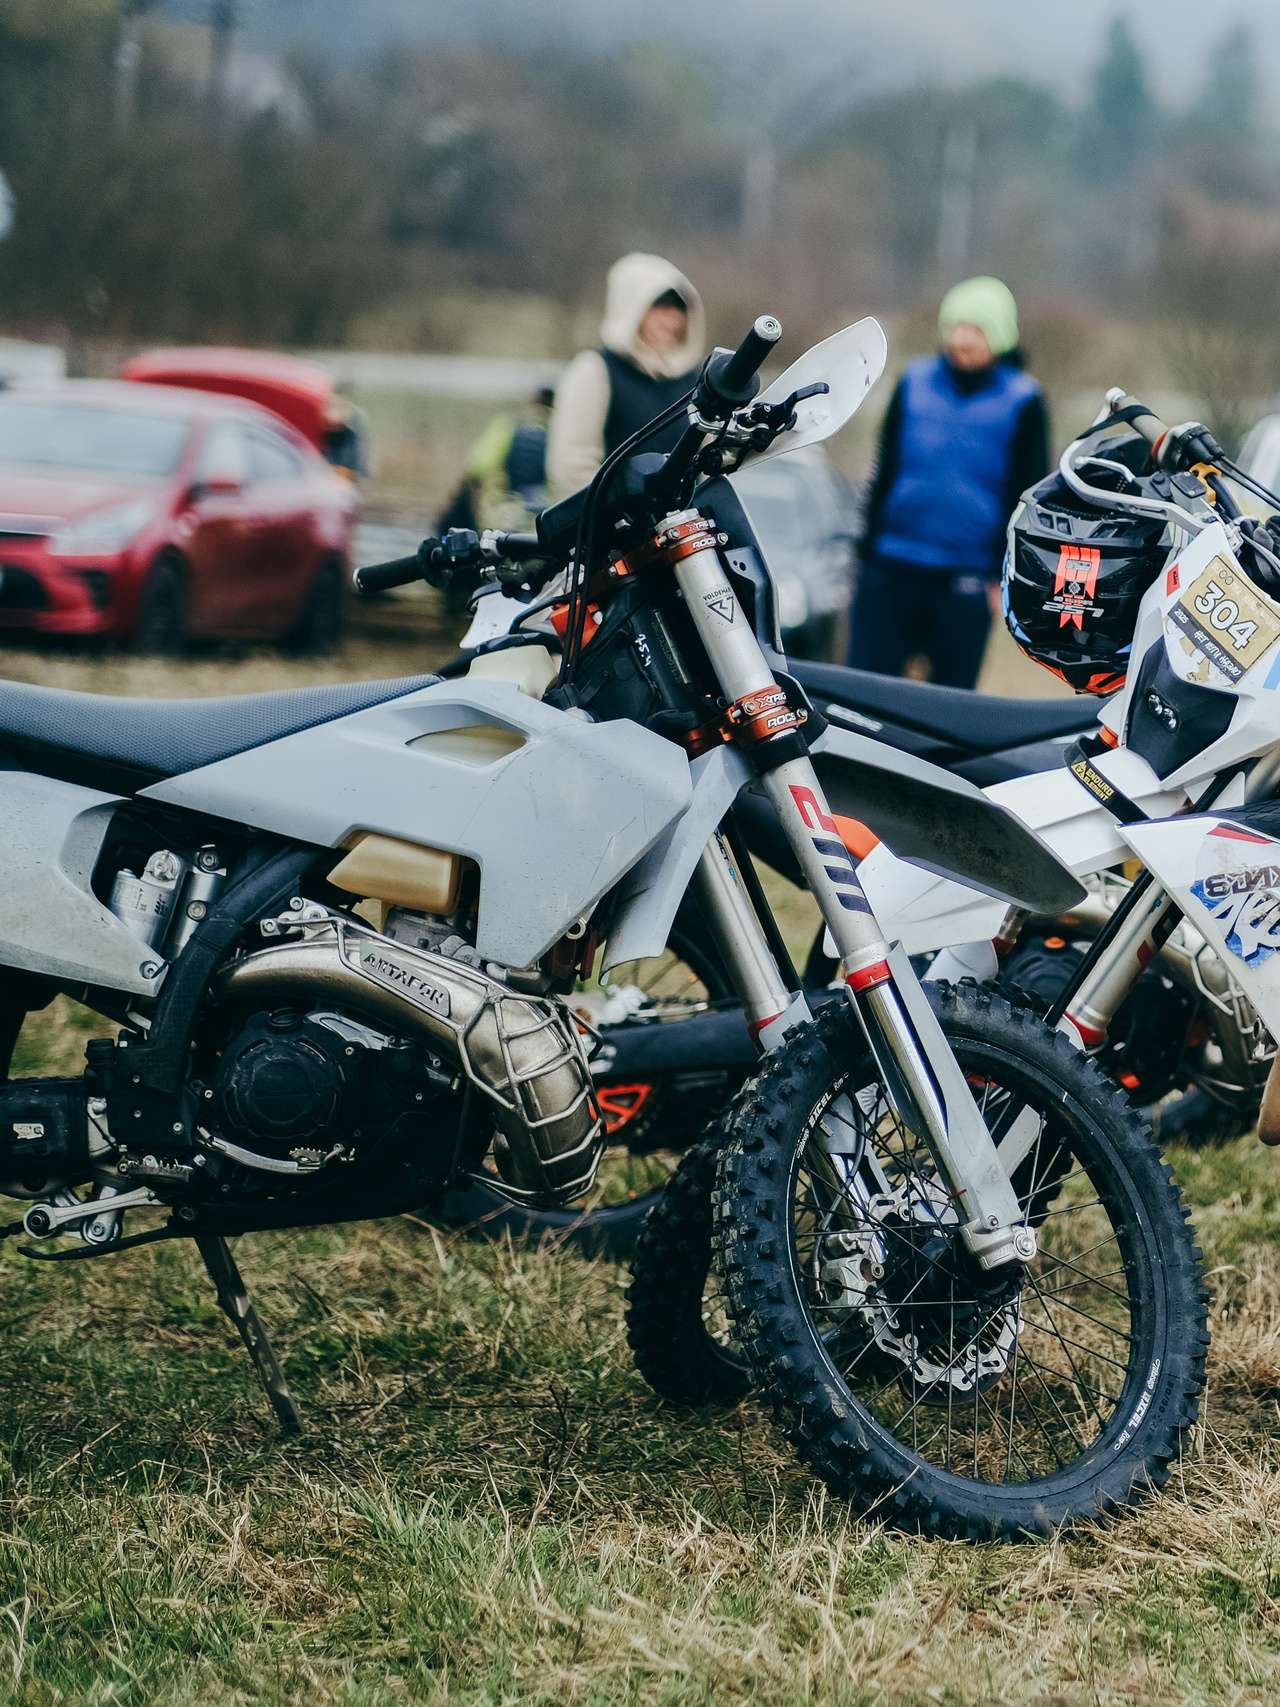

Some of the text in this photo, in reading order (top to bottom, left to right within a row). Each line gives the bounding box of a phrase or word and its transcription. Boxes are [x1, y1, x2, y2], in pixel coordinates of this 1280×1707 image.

[1173, 608, 1189, 624] 2025
[1194, 580, 1259, 650] 304
[755, 692, 787, 708] XTRIG
[767, 712, 796, 729] ROCS
[1083, 776, 1109, 801] ELEMENT
[1086, 768, 1115, 797] ENDURO
[808, 1092, 832, 1128] EXCEL
[1128, 1391, 1152, 1428] EXCEL
